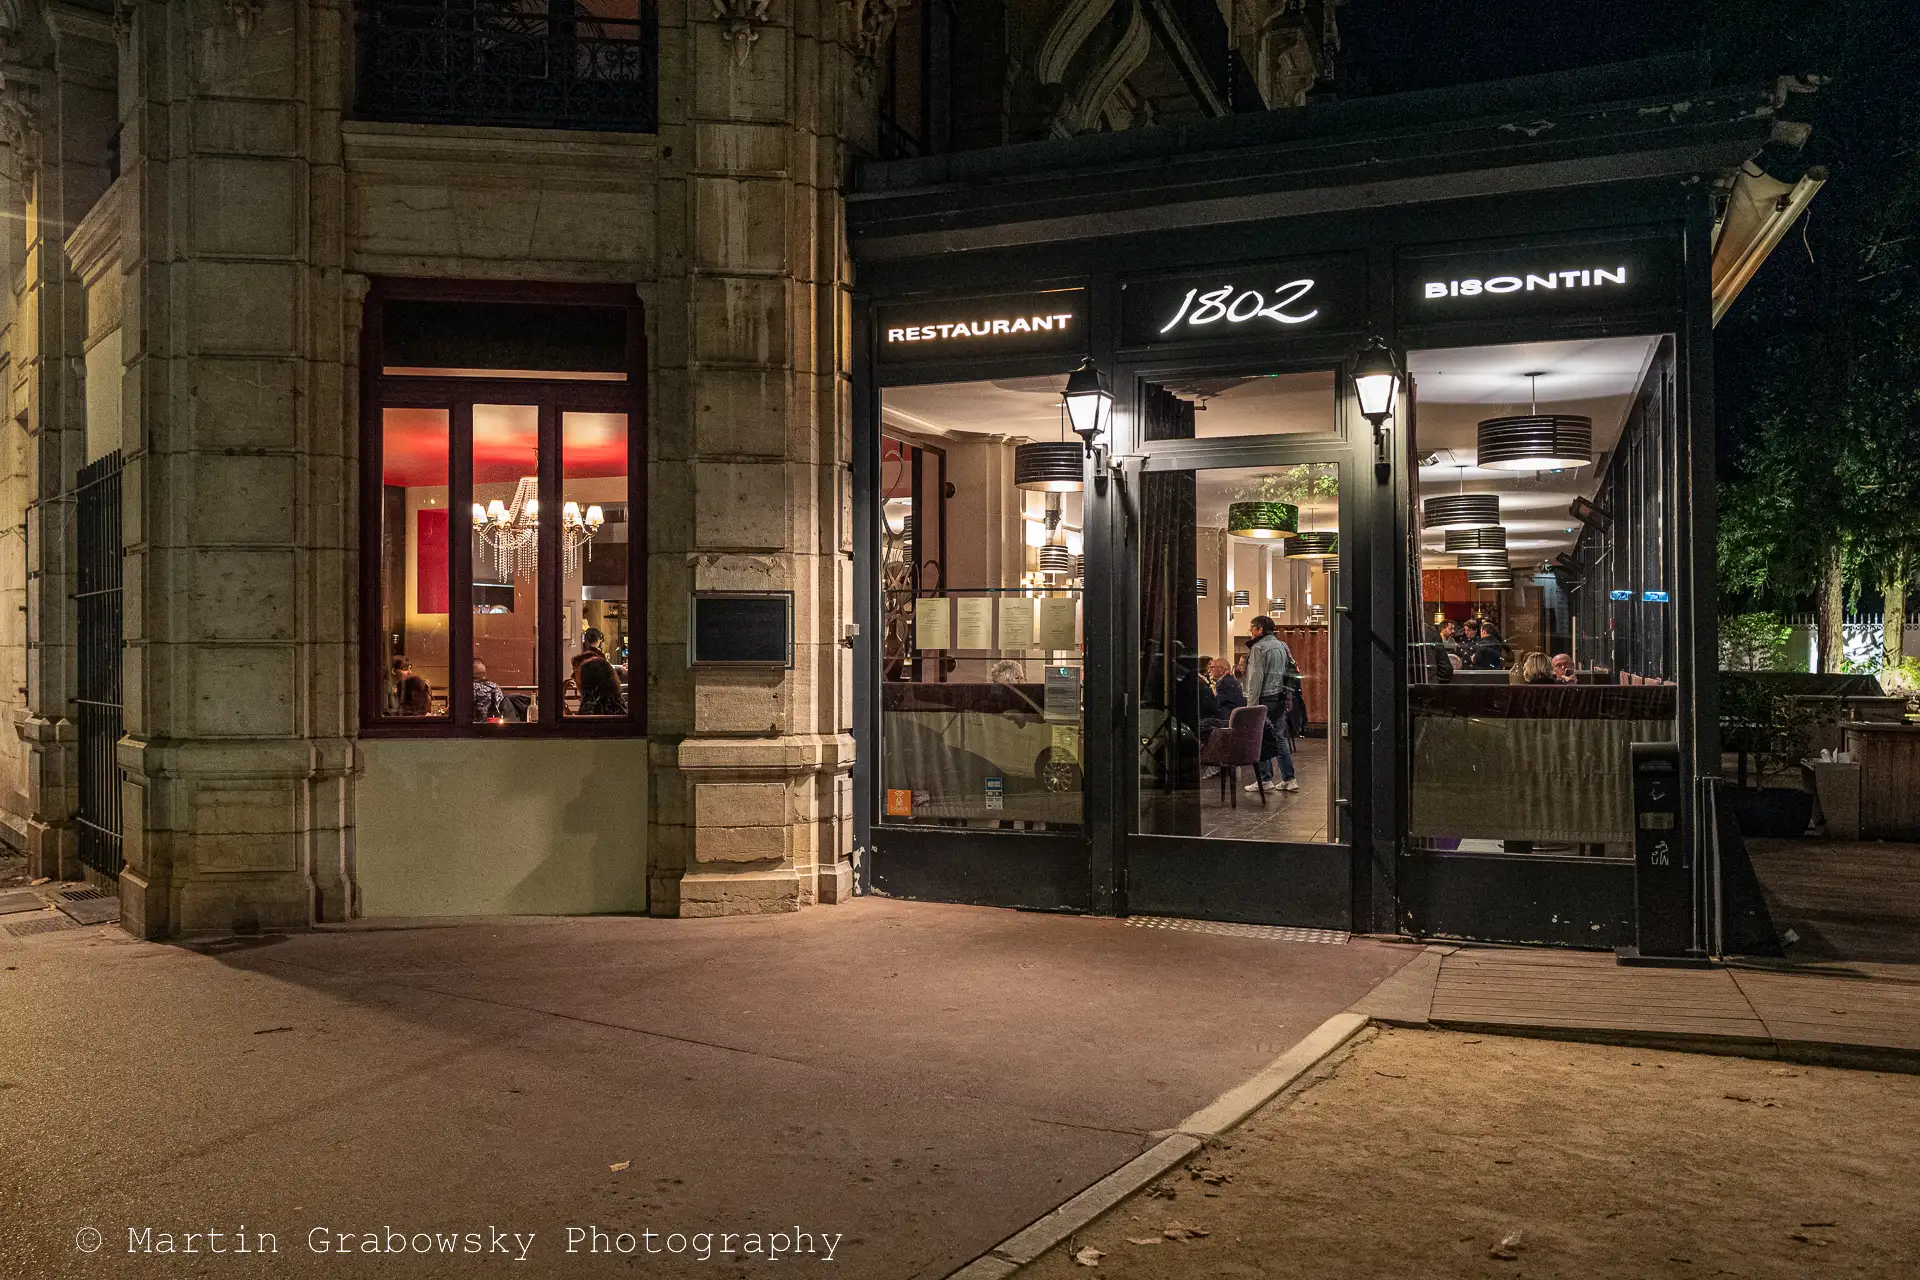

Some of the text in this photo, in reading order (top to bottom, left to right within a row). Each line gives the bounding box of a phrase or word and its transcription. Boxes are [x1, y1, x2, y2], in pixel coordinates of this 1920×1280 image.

[1423, 265, 1627, 300] BISONTIN
[1158, 278, 1319, 334] 1802
[887, 312, 1074, 344] RESTAURANT
